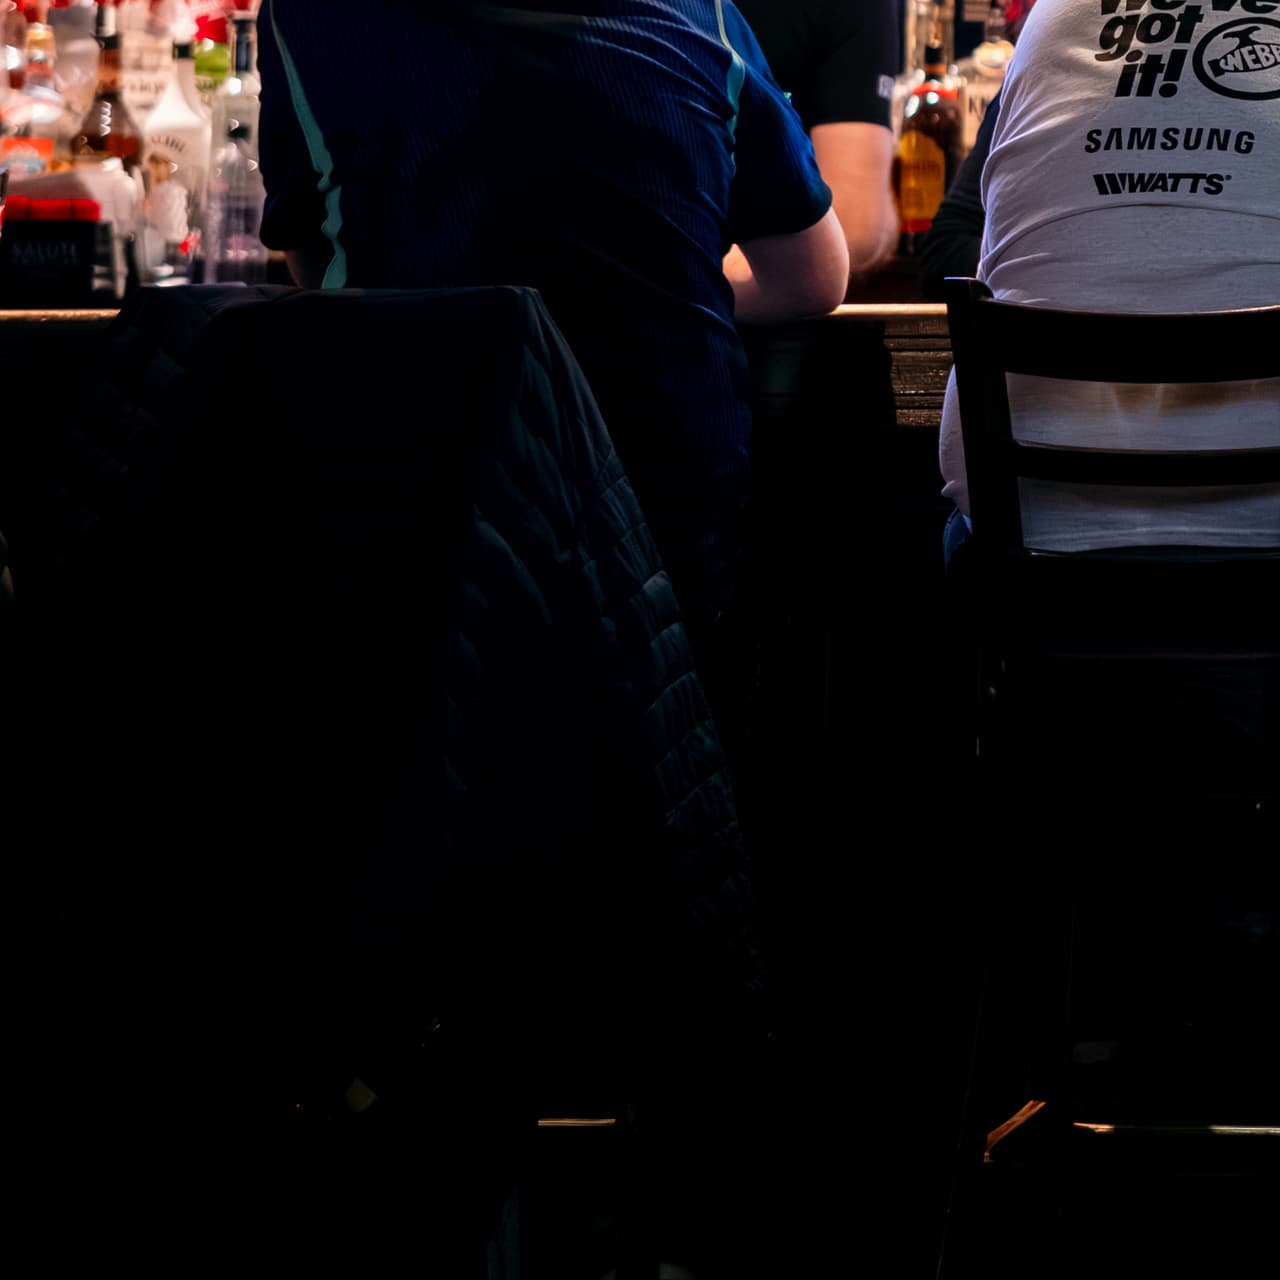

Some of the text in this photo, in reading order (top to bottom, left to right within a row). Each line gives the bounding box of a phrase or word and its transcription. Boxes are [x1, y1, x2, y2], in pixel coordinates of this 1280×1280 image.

[1094, 5, 1205, 62] got
[1114, 48, 1188, 98] it!
[1084, 126, 1256, 154] SAMSUNG
